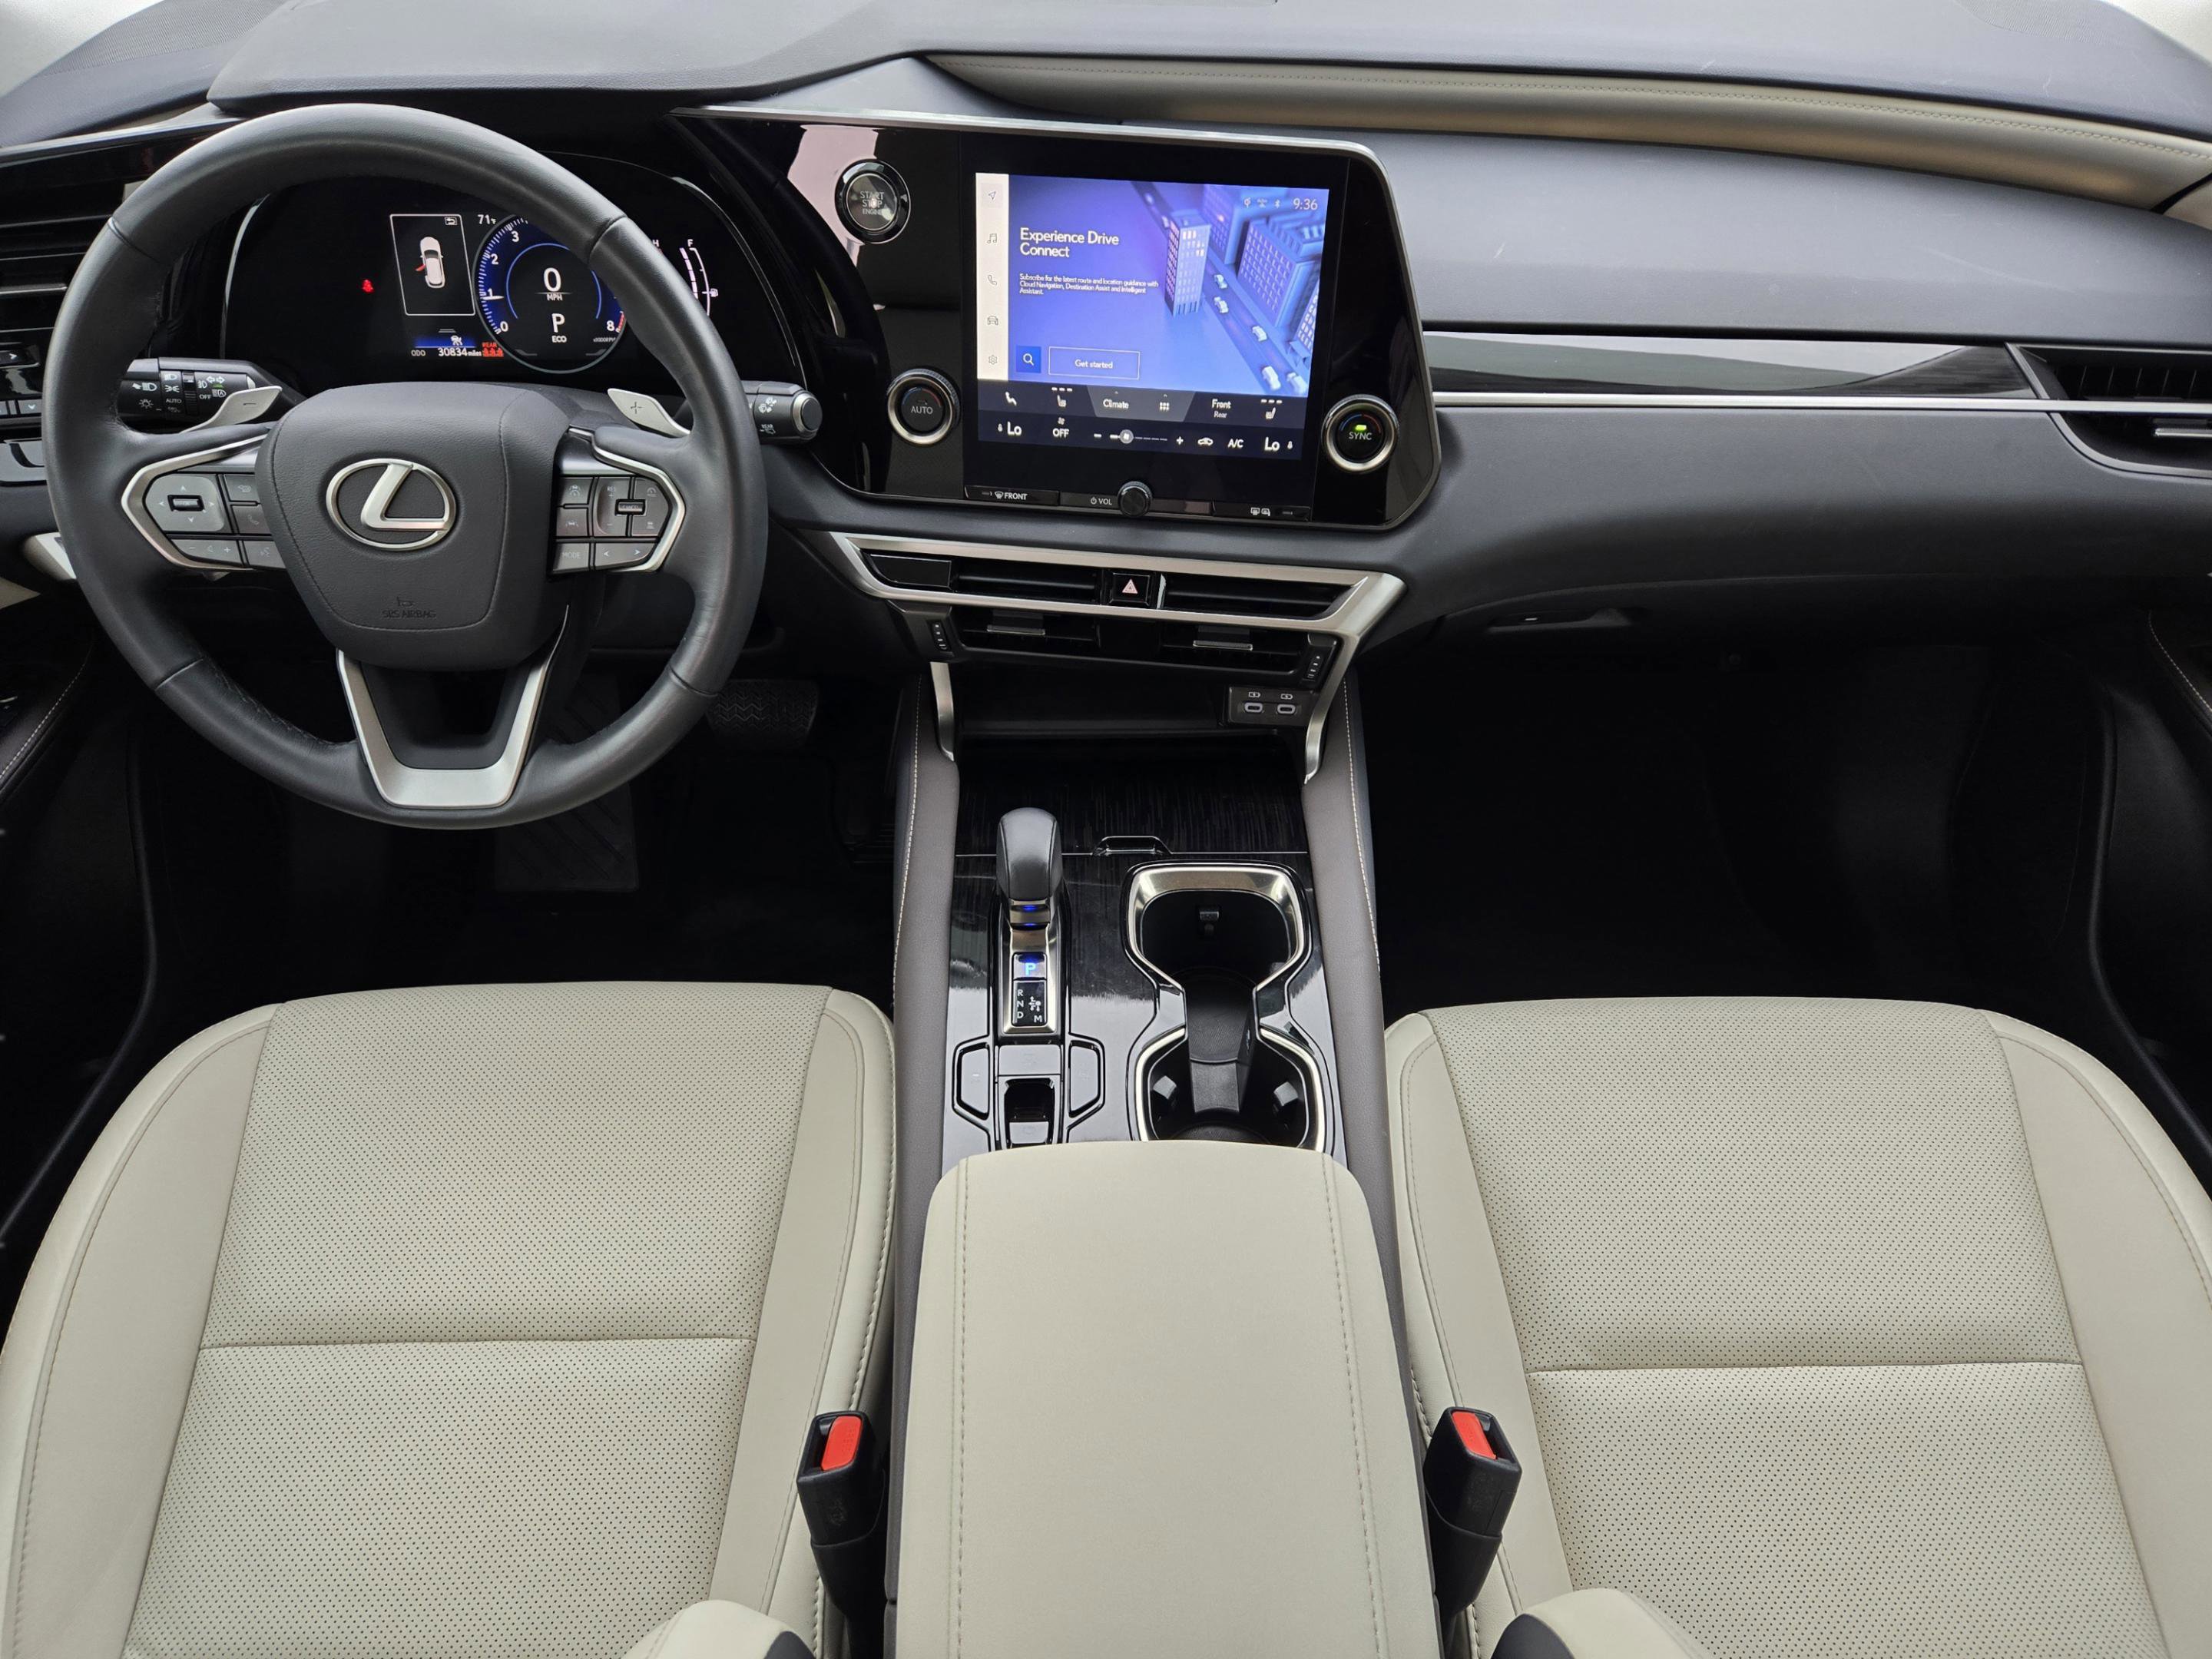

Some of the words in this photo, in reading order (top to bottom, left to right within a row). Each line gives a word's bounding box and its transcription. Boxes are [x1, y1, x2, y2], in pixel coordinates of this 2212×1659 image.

[860, 191, 884, 200] START
[862, 199, 882, 208] STOP
[1293, 197, 1318, 210] 9:36
[512, 230, 519, 242] 3
[1020, 227, 1084, 244] Experience
[1088, 230, 1119, 245] Drive
[1020, 242, 1070, 257] Connect
[491, 253, 498, 264] 2
[543, 267, 561, 292] 0
[1065, 283, 1094, 291] Destination
[500, 321, 508, 332] 0
[551, 313, 565, 333] P
[606, 320, 615, 331] 8
[438, 348, 468, 357] 30834
[1075, 359, 1088, 368] Get
[1103, 399, 1129, 409] Climate
[1211, 399, 1231, 409] Front
[910, 406, 933, 415] AUTO
[1007, 421, 1022, 436] Lo
[1052, 428, 1070, 439] OFF
[1349, 432, 1373, 440] SYNC
[1227, 439, 1244, 449] A/C
[1264, 437, 1280, 452] Lo
[402, 610, 436, 618] AIRBAG
[1025, 962, 1036, 976] P
[1033, 1015, 1043, 1023] M
